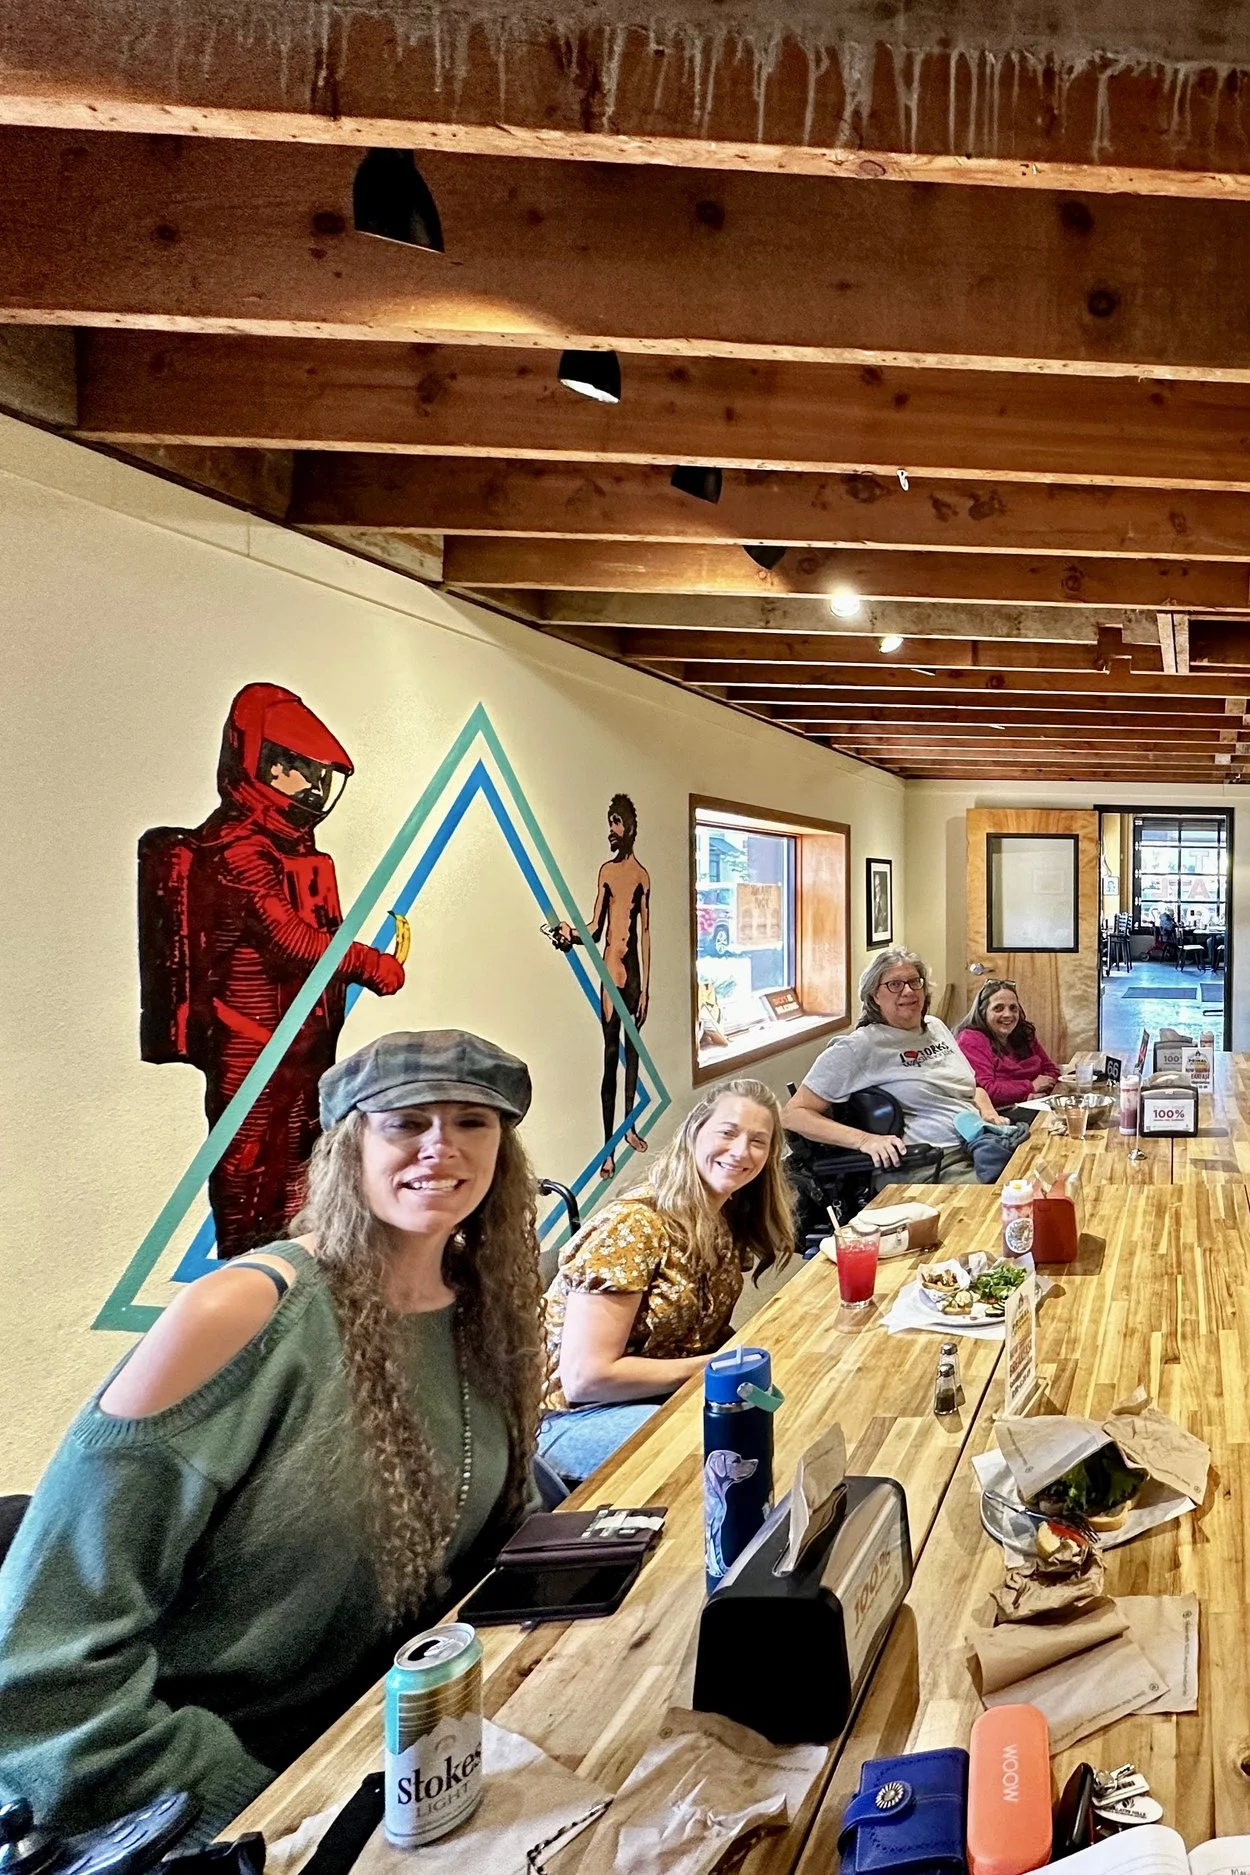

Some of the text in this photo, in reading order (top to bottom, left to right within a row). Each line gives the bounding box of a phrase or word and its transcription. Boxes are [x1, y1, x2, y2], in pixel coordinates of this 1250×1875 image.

[1107, 1060, 1119, 1078] 66
[1153, 1109, 1185, 1119] 100%
[853, 1548, 892, 1624] 100%
[1002, 1744, 1019, 1802] WOOW
[417, 1780, 470, 1817] LIGHT
